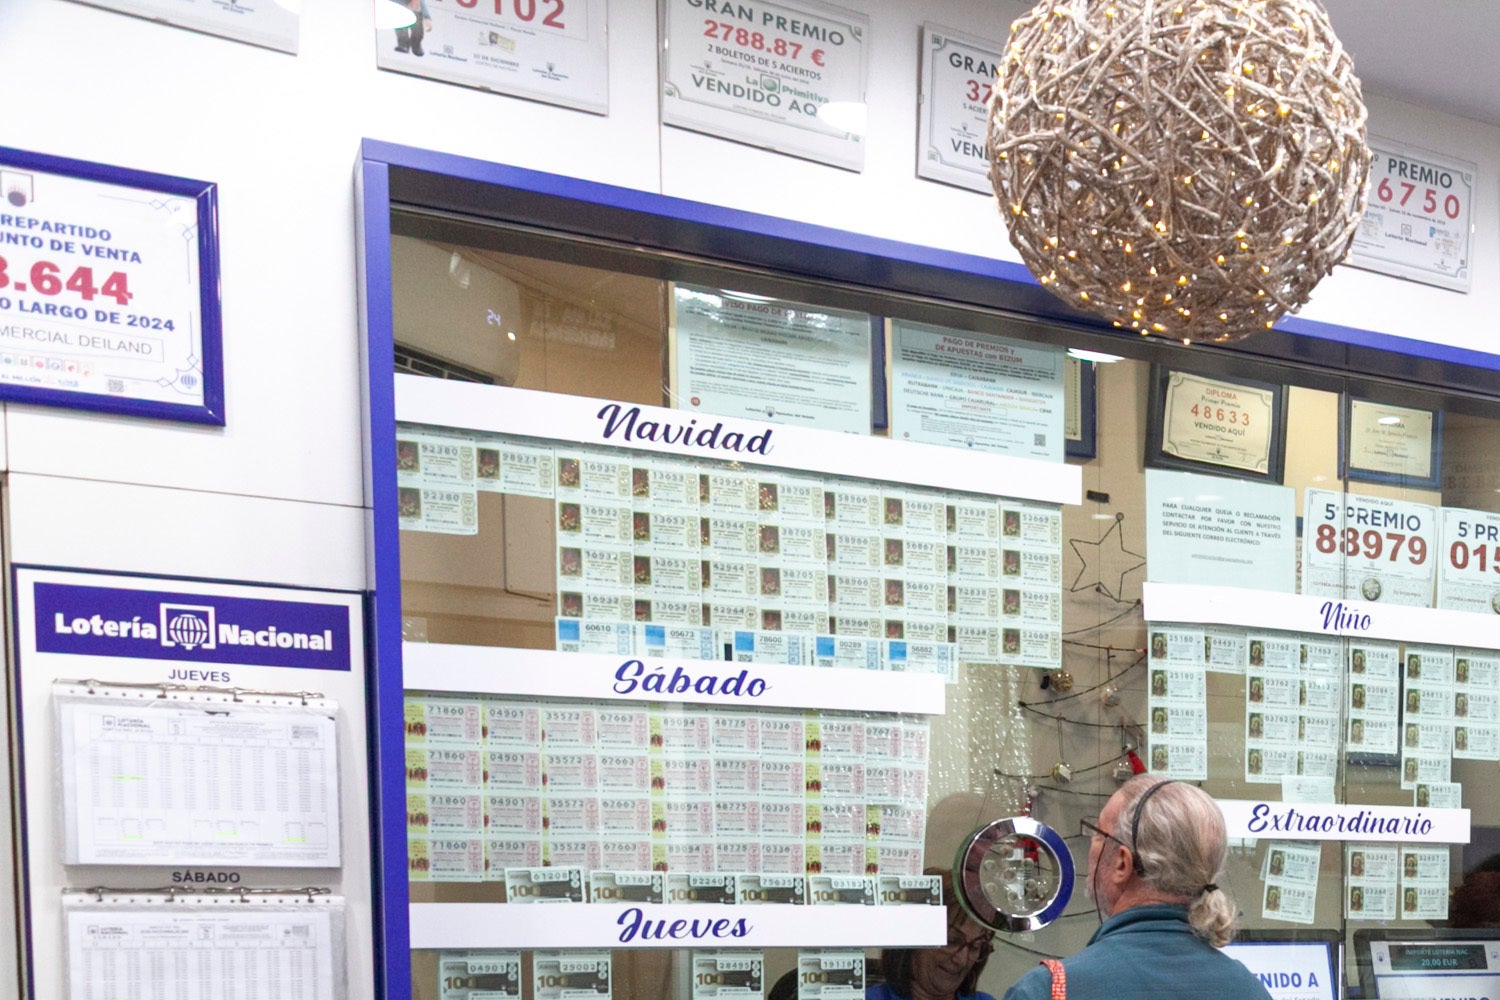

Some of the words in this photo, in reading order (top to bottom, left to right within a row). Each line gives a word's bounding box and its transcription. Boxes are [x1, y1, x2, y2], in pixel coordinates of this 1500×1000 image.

[763, 12, 845, 46] PREMIO
[704, 19, 802, 60] 2788.87
[811, 50, 825, 67] €
[715, 46, 756, 63] BOLETOS
[758, 57, 769, 68] DE
[780, 63, 822, 81] ACIERTOS
[692, 73, 781, 107] VENDIDO
[746, 76, 759, 86] La
[1388, 158, 1453, 189] PREMIO
[1, 213, 112, 242] REPARTIDO
[50, 239, 76, 254] DE
[81, 243, 142, 264] VENTA
[19, 299, 87, 320] LARGO
[95, 309, 122, 325] DE
[127, 314, 175, 332] 2024
[79, 333, 152, 355] DEILAND
[1206, 388, 1237, 400] DIPLOMA
[1191, 403, 1250, 426] 48633
[1194, 421, 1226, 433] VENDIDO
[597, 403, 775, 456] Navidad
[1181, 504, 1212, 513] CUALQUIER
[1346, 506, 1420, 531] PREMIO
[1316, 524, 1427, 566] 88979
[1320, 601, 1374, 631] Niño
[55, 613, 157, 639] Lotería
[219, 624, 332, 651] Nacional
[169, 669, 231, 682] JUEVES
[613, 660, 773, 698] Sábado
[428, 706, 463, 715] 71860
[490, 708, 524, 717] 04901
[715, 719, 745, 727] 48775
[1247, 804, 1435, 837] Extraordinario
[172, 870, 240, 883] SÁBADO
[617, 907, 754, 943] Jueves
[470, 964, 505, 972] 04901
[719, 961, 749, 969] 28495
[1442, 959, 1458, 967] EUR
[1308, 972, 1319, 987] A
